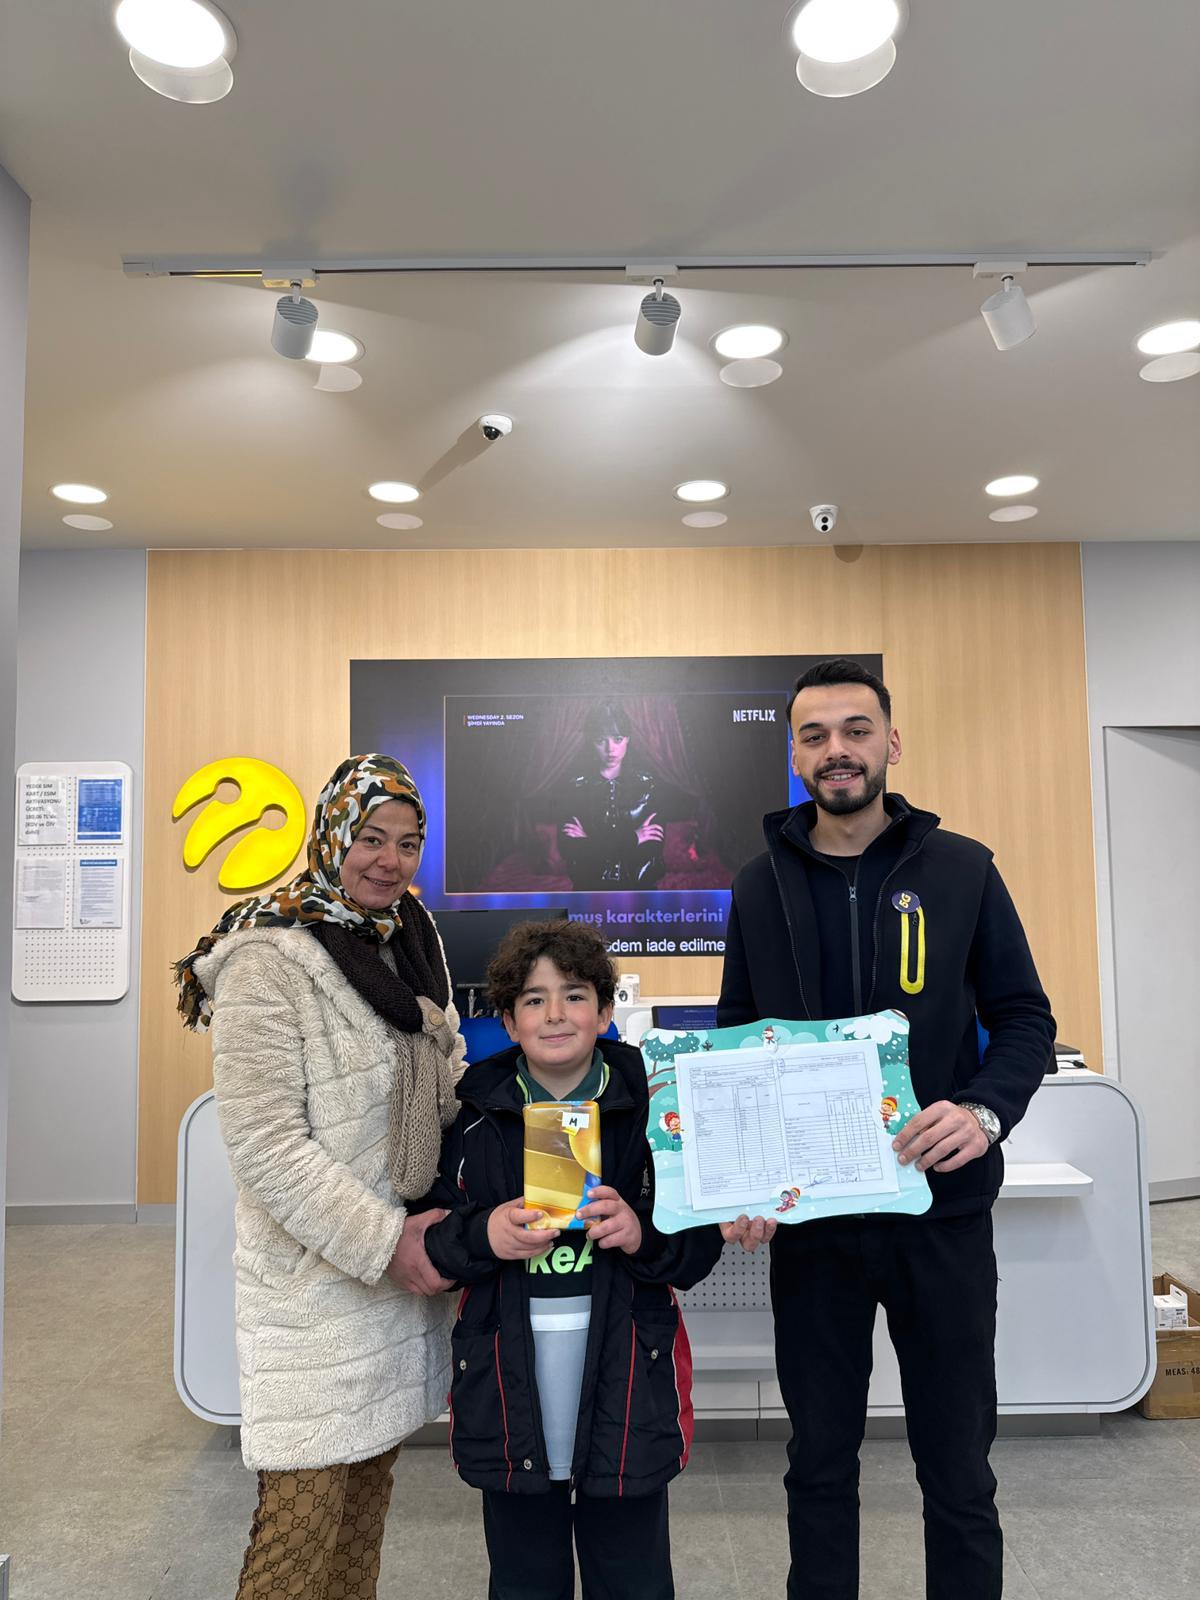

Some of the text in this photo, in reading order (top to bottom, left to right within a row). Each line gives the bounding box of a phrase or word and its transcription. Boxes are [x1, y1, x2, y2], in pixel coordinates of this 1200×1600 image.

[733, 709, 776, 723] NETFLIX
[606, 908, 724, 924] karakterlerini
[647, 938, 676, 952] iade
[679, 938, 726, 952] edilme
[569, 1117, 578, 1127] M
